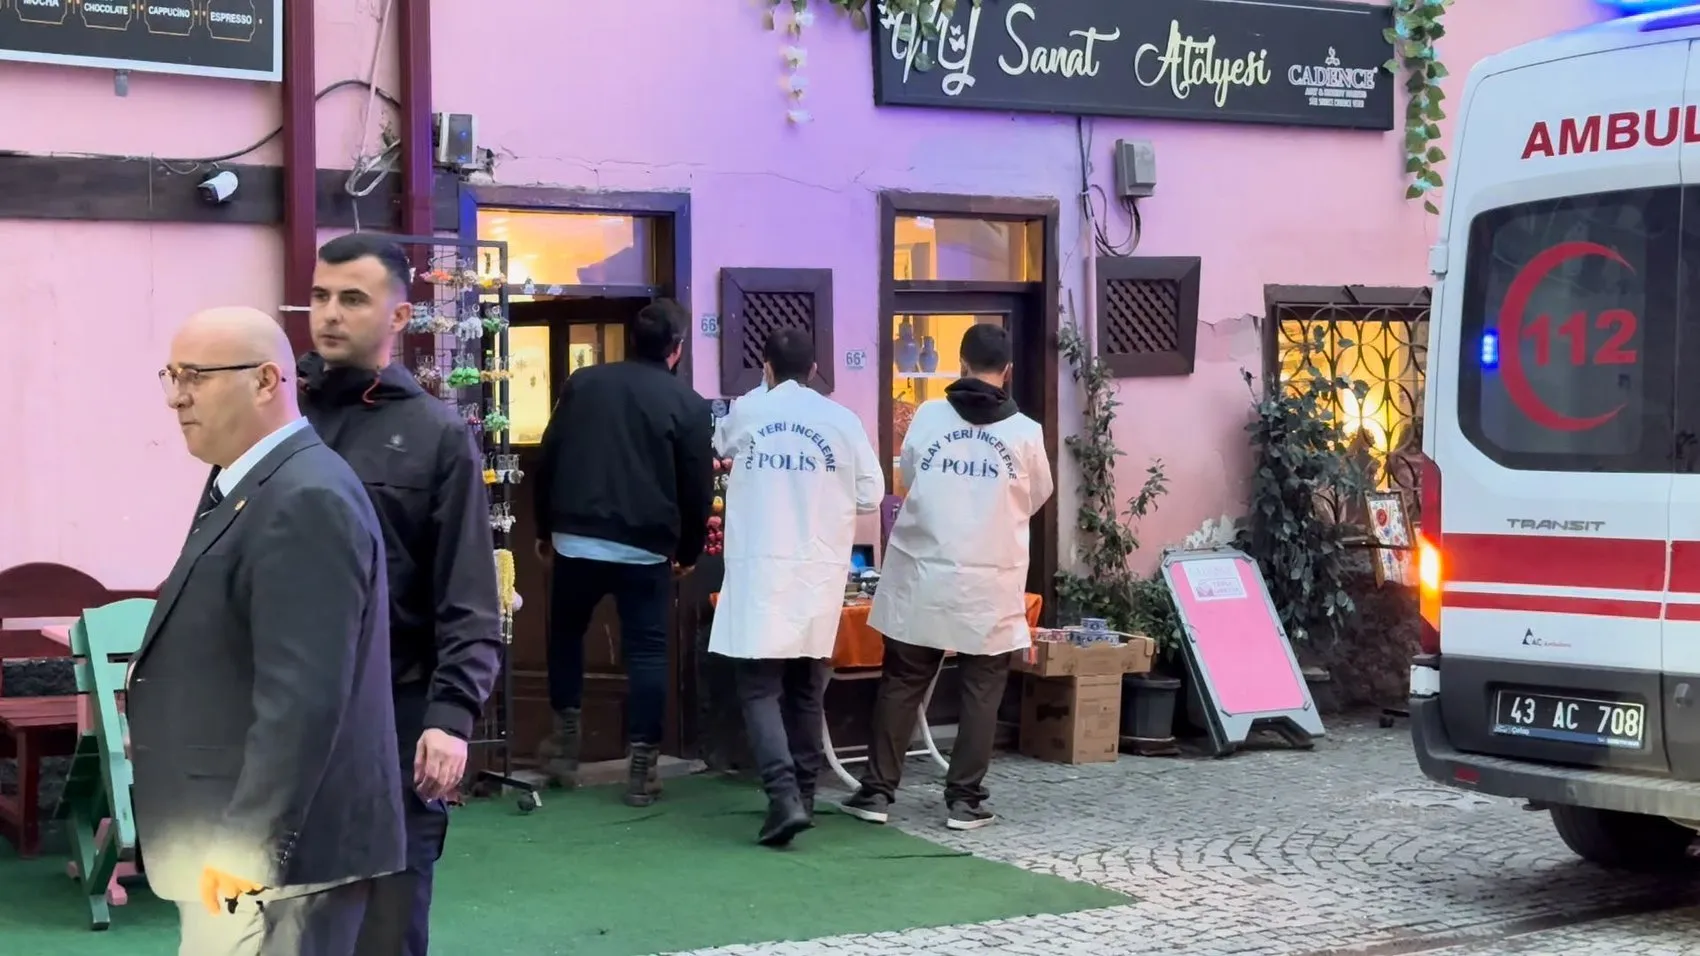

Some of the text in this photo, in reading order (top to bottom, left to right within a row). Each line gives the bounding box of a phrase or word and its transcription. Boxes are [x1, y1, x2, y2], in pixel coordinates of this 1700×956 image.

[83, 3, 129, 16] CHOCOLATE
[210, 12, 253, 25] ESPRESSO
[998, 3, 1120, 78] Sanat
[1134, 20, 1272, 107] Atölyesi
[1288, 64, 1376, 90] CADENCE
[1521, 105, 1700, 160] AMBUL
[700, 318, 717, 332] 66
[1523, 308, 1638, 367] 112
[758, 450, 818, 473] POLİS
[920, 440, 942, 472] OLAY
[944, 427, 973, 443] YERİ
[941, 457, 1000, 479] POLİS
[1507, 518, 1606, 532] TRANSIT
[1510, 696, 1639, 737] 43 AC 708
